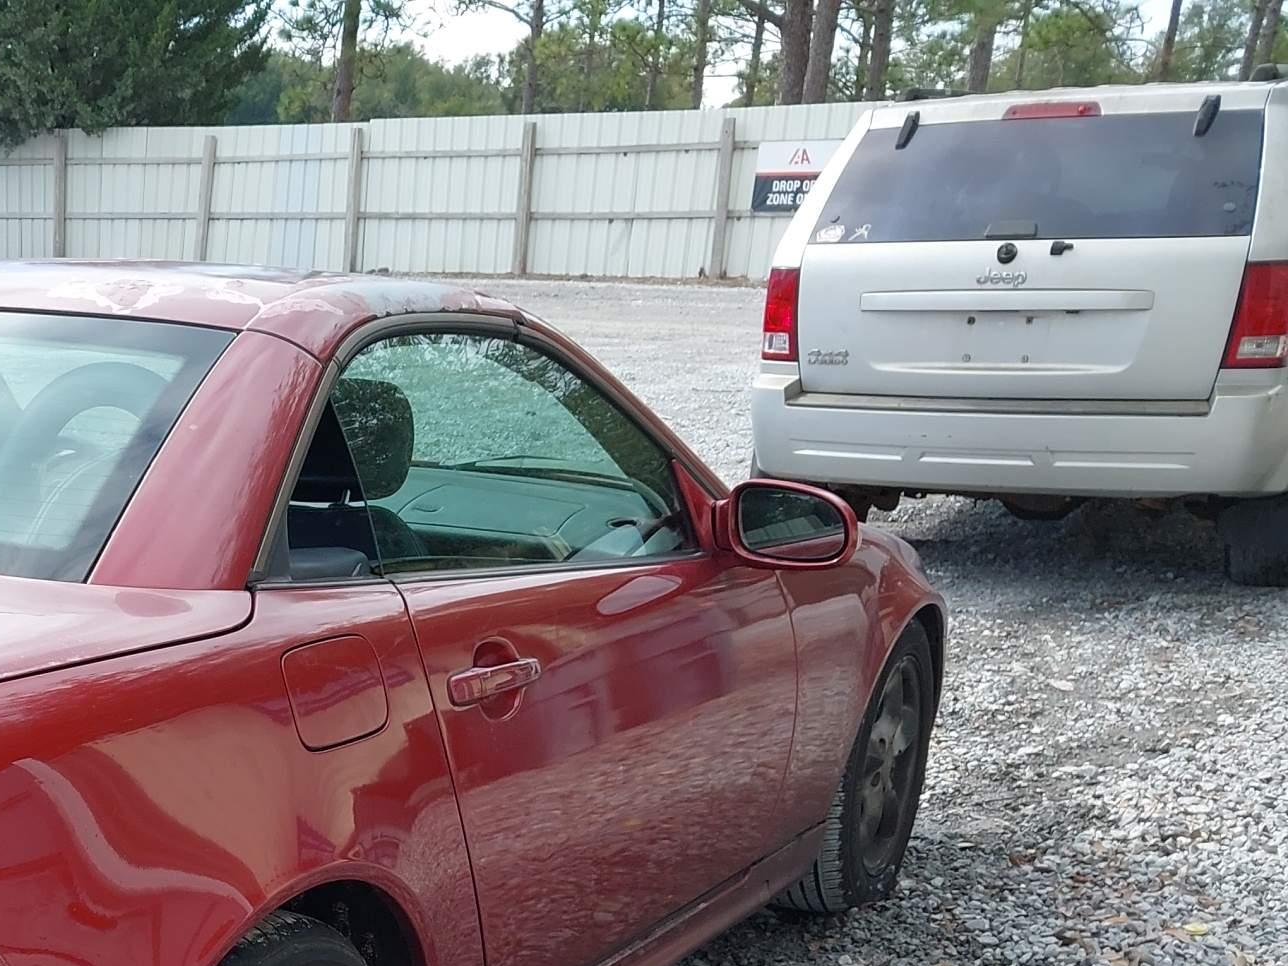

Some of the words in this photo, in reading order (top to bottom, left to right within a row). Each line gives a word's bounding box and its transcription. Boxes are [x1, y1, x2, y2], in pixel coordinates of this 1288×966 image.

[772, 180, 801, 192] DROP
[766, 193, 795, 205] ZONE
[976, 267, 1028, 288] Jeep
